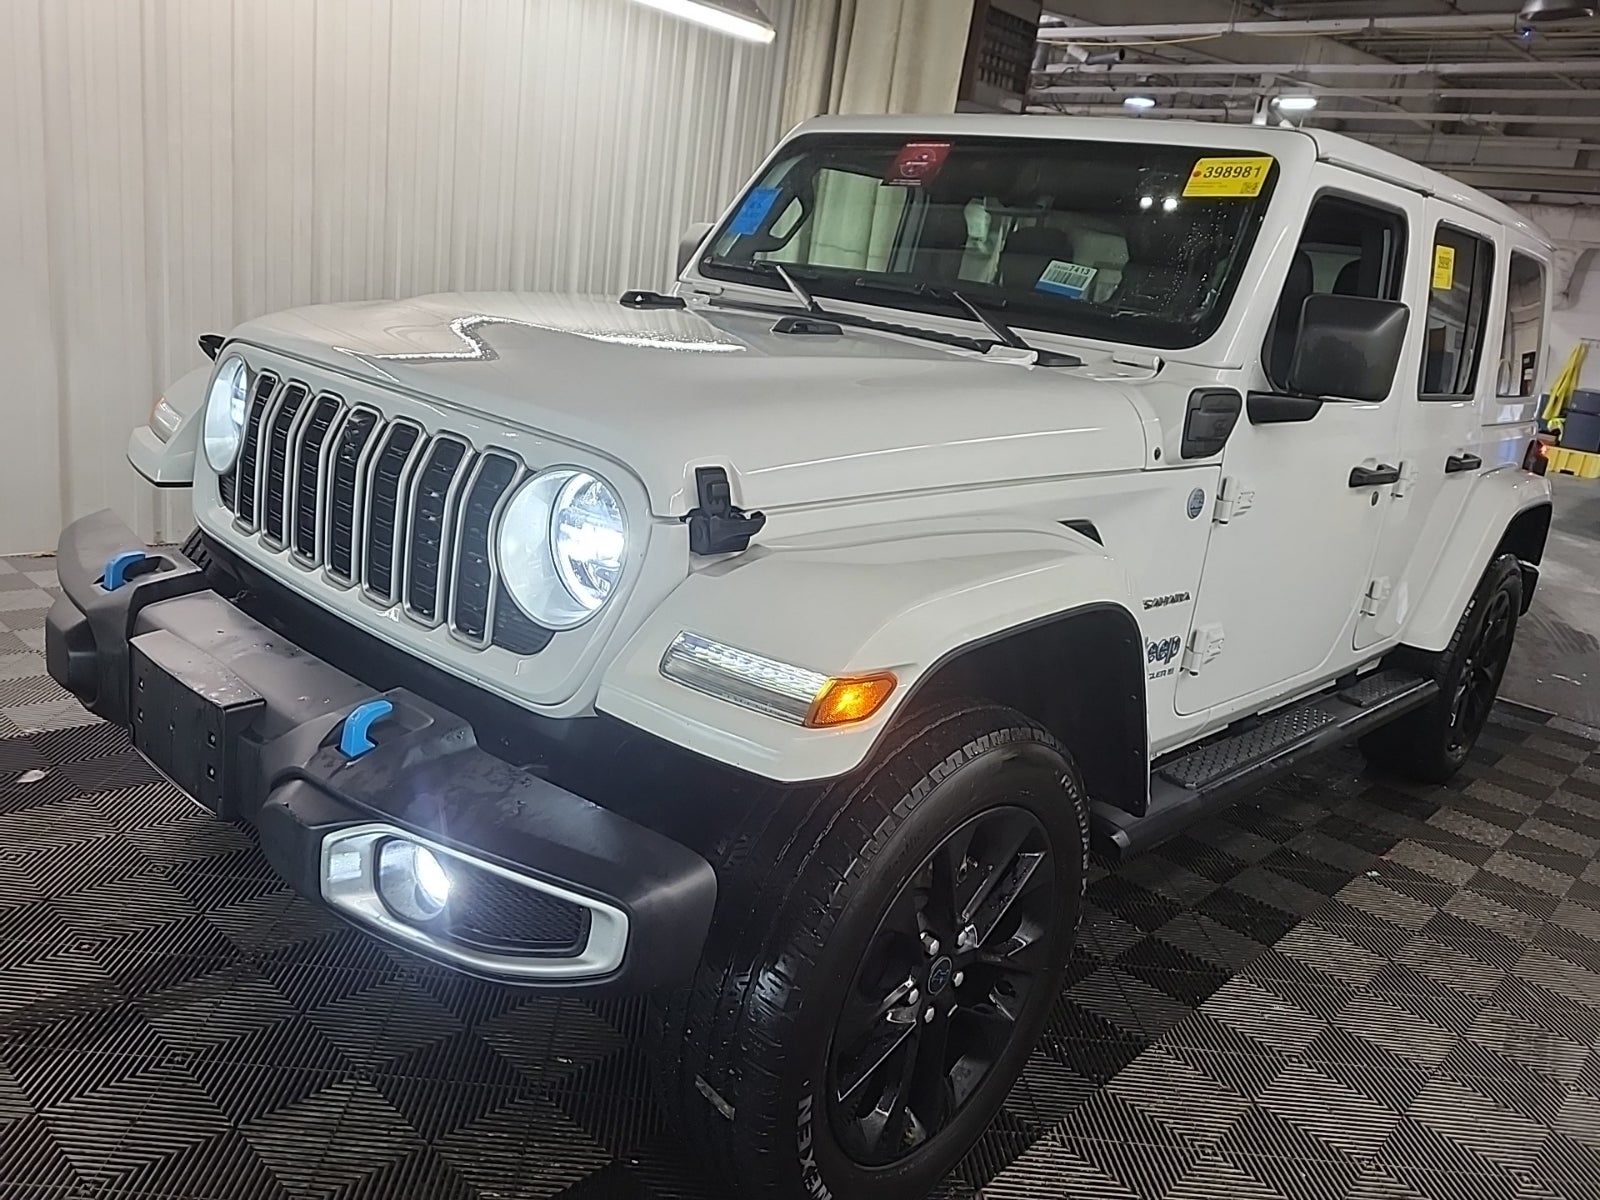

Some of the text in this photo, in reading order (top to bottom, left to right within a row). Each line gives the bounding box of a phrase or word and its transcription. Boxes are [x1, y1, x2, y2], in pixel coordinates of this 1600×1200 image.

[1203, 166, 1262, 178] 398981
[1068, 266, 1091, 276] 7413
[1143, 592, 1191, 610] SAHARA
[1145, 636, 1181, 665] eep
